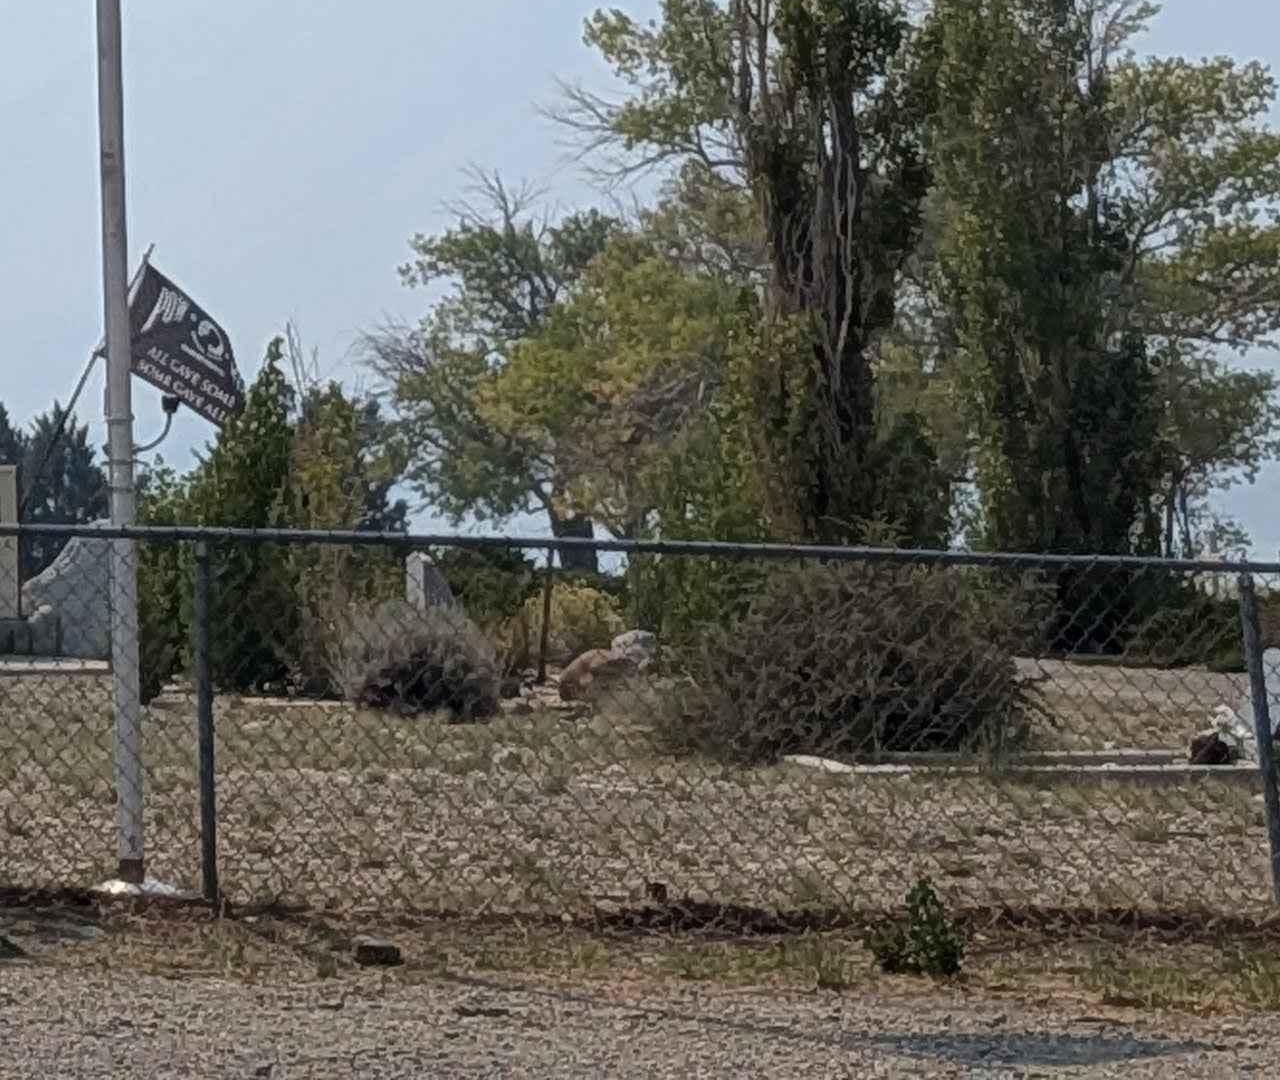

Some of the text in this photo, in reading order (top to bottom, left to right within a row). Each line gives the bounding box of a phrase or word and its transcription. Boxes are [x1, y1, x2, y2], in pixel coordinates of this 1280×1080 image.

[147, 346, 236, 407] ALL GAVE SOME
[173, 381, 204, 407] GAVE
[204, 403, 226, 422] ALL
